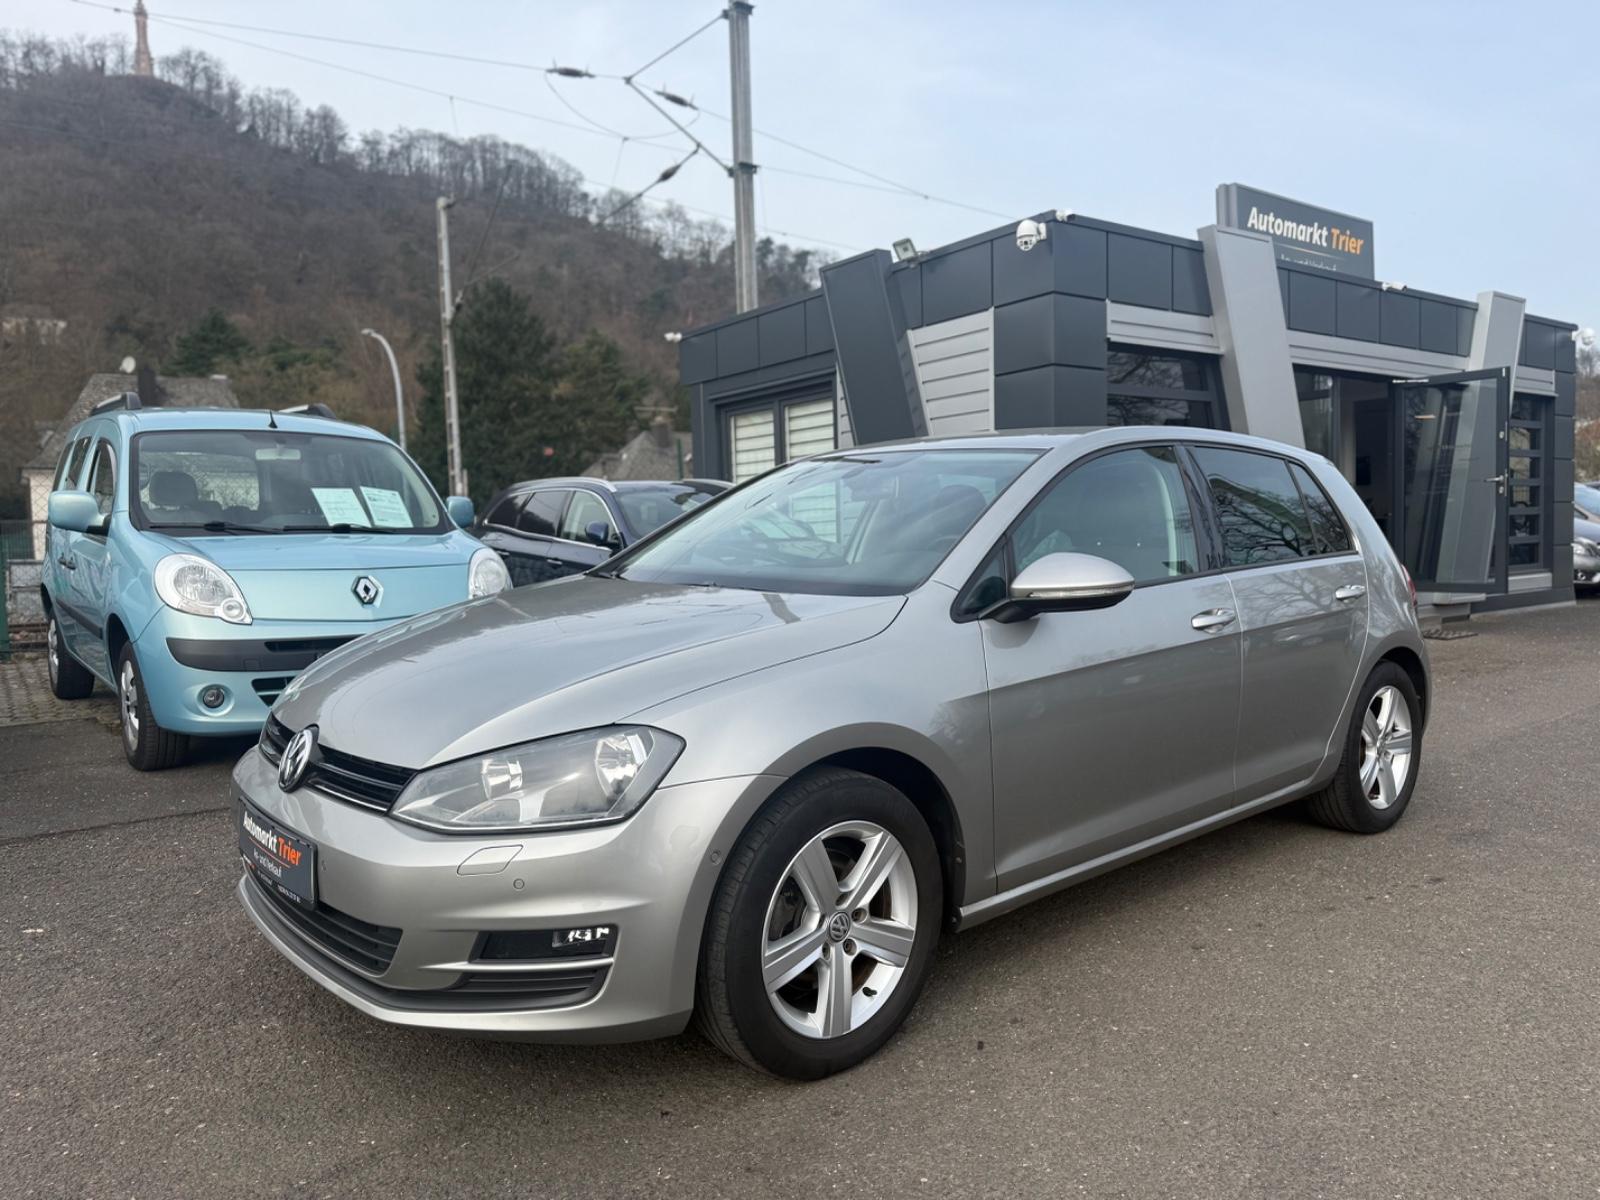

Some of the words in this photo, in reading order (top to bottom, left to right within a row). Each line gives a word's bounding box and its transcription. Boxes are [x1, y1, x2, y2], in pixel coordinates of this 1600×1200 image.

[1247, 206, 1328, 247] Automarkt
[1331, 228, 1364, 255] Trier
[243, 811, 278, 853] Automarkt
[278, 837, 302, 866] Trier
